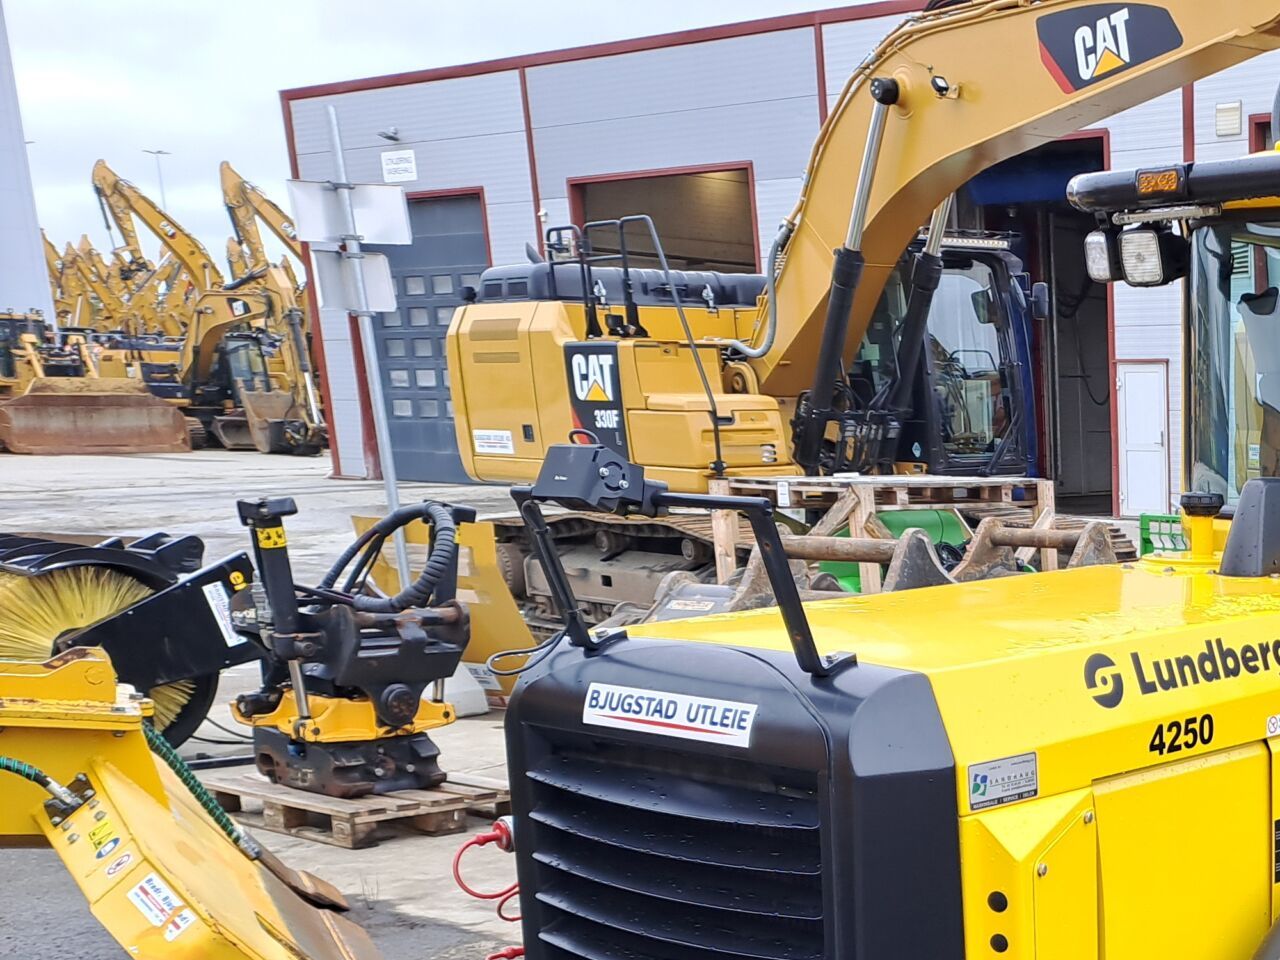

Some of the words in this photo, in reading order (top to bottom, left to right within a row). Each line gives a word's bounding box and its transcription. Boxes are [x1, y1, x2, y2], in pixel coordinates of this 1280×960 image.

[1074, 7, 1130, 80] CAT
[572, 353, 614, 401] CAT
[594, 410, 620, 429] 330F
[588, 690, 678, 719] BJUGSTAD
[687, 703, 750, 730] UTLEIE
[1149, 713, 1214, 756] 4250
[989, 769, 1035, 785] SANDHAUG
